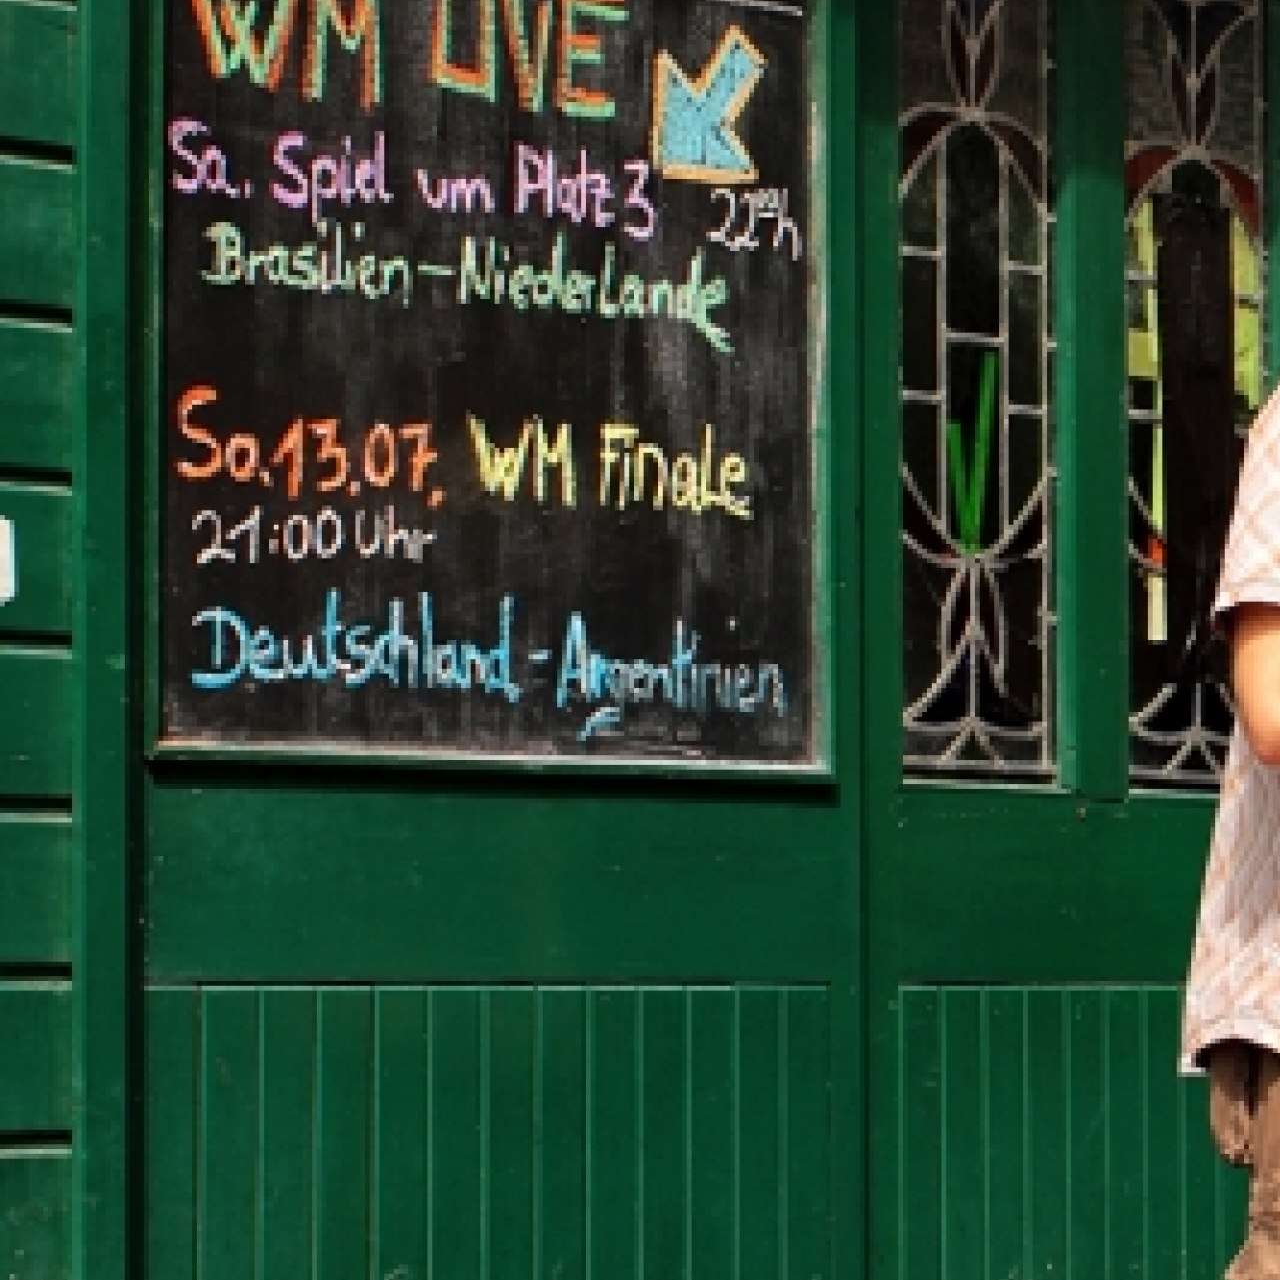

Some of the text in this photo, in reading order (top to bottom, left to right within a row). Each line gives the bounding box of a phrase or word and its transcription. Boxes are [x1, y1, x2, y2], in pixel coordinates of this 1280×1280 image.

[270, 130, 394, 227] Spiel
[415, 163, 496, 217] um
[513, 141, 614, 233] Platz
[621, 159, 656, 242] 3
[468, 412, 573, 506] WM
[193, 508, 437, 564] 21:00 Uhr
